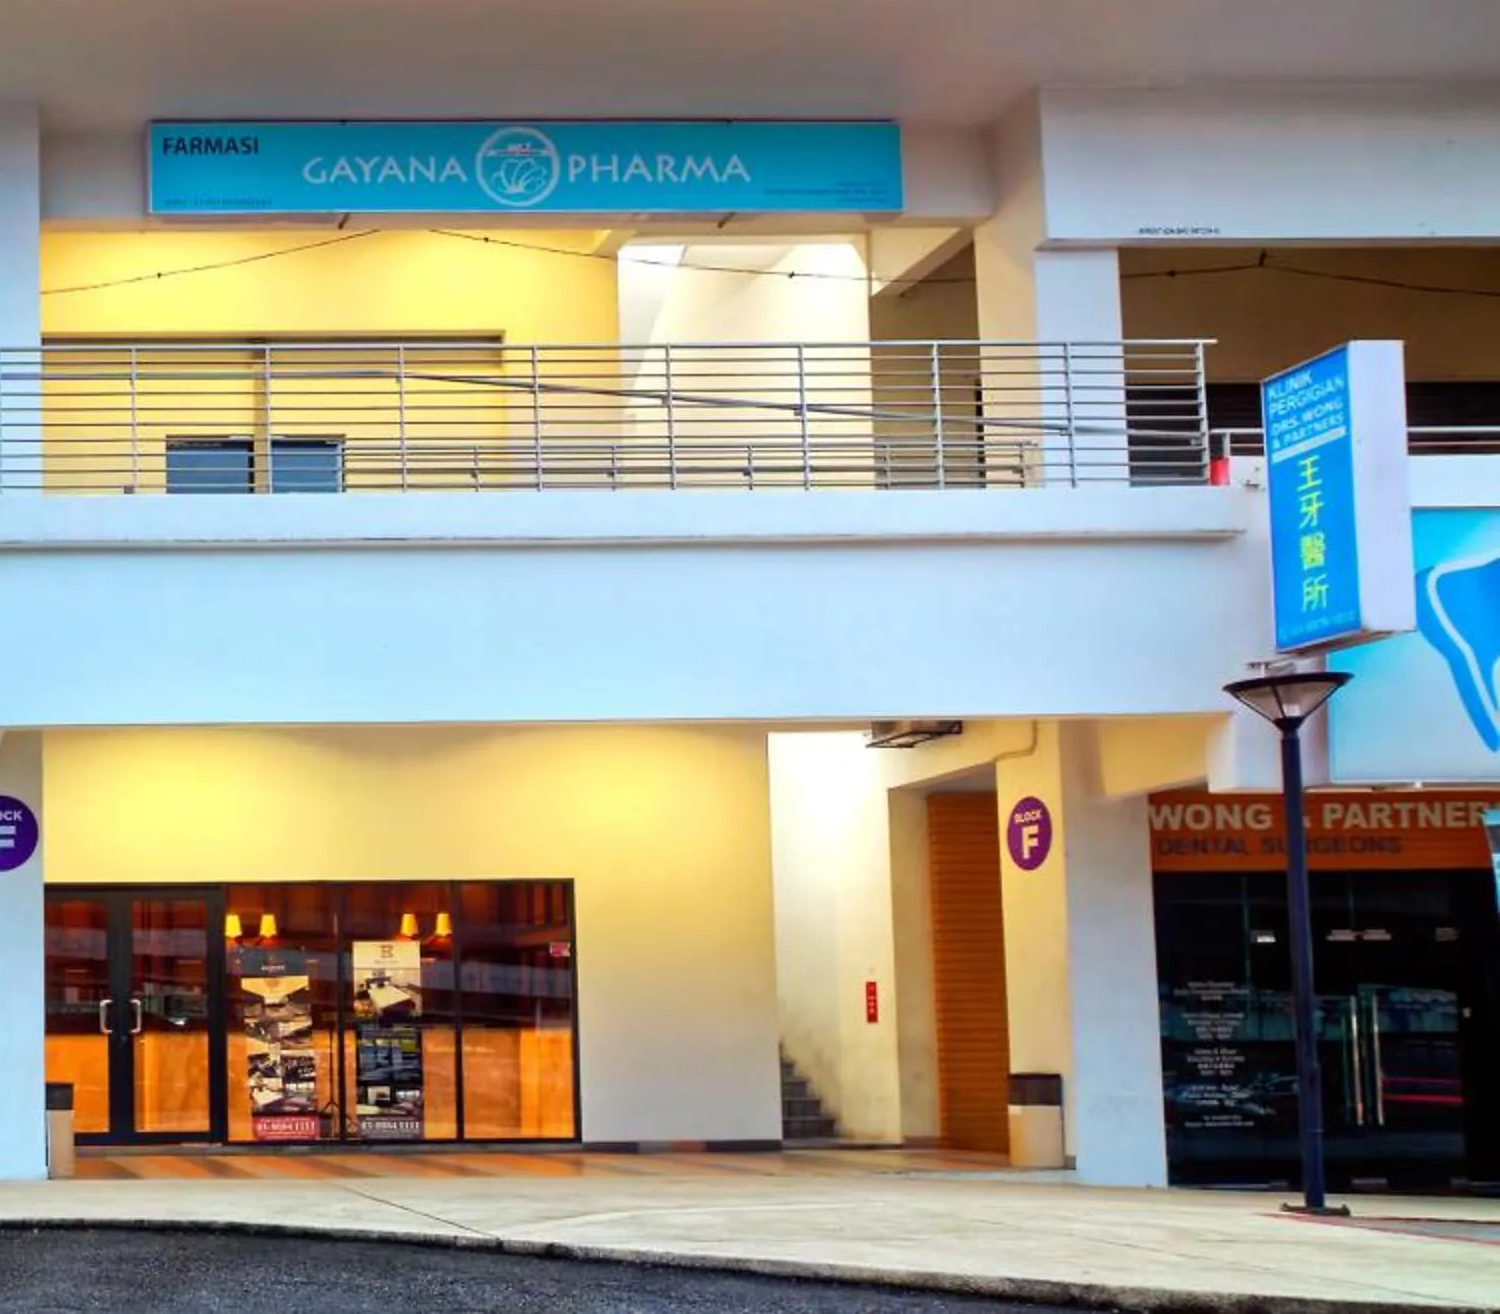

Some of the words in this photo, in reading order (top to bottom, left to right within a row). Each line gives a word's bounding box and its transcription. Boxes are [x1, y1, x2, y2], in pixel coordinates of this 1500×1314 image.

[162, 136, 260, 156] FARMASI
[302, 155, 468, 185] GAYANA
[568, 154, 752, 184] PHARMA
[1150, 803, 1273, 831] WONG
[1321, 800, 1499, 829] PARTNER
[1021, 824, 1040, 860] F
[1259, 835, 1404, 856] SUGEONS
